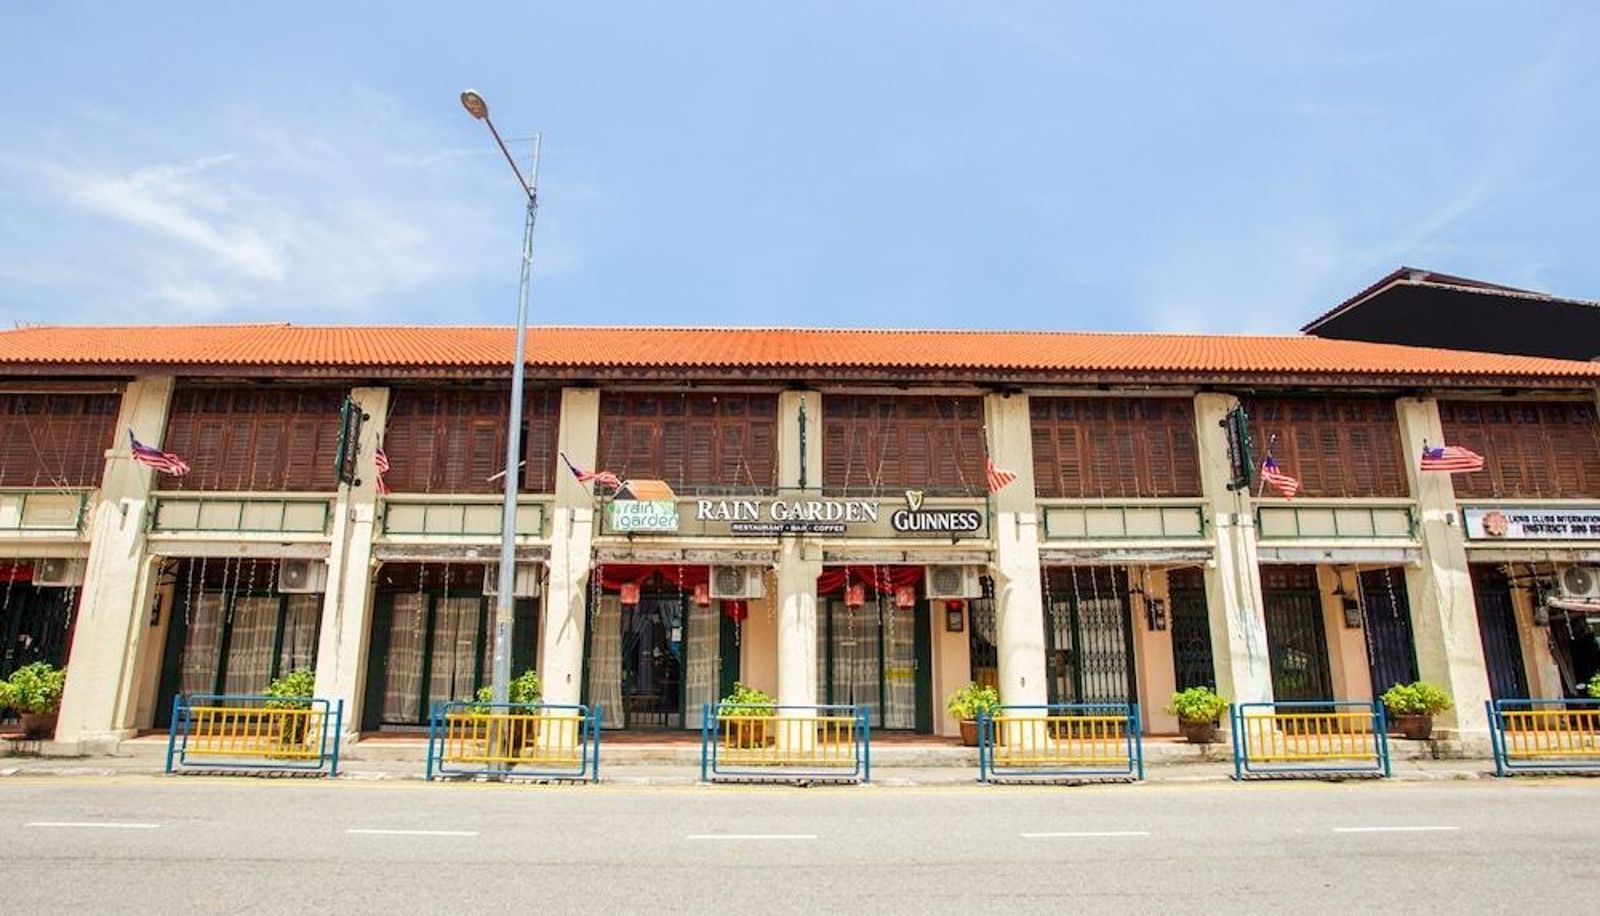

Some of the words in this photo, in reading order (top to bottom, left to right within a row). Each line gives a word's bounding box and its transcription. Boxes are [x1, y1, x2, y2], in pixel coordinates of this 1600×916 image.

[623, 501, 654, 514] rain
[697, 500, 760, 521] RAIN
[770, 500, 880, 522] GARDEN
[620, 514, 678, 530] garden
[732, 524, 784, 532] RESTAURANT
[790, 524, 808, 532] BAR
[813, 524, 844, 532] COFFEE
[894, 510, 979, 530] GUINNESS
